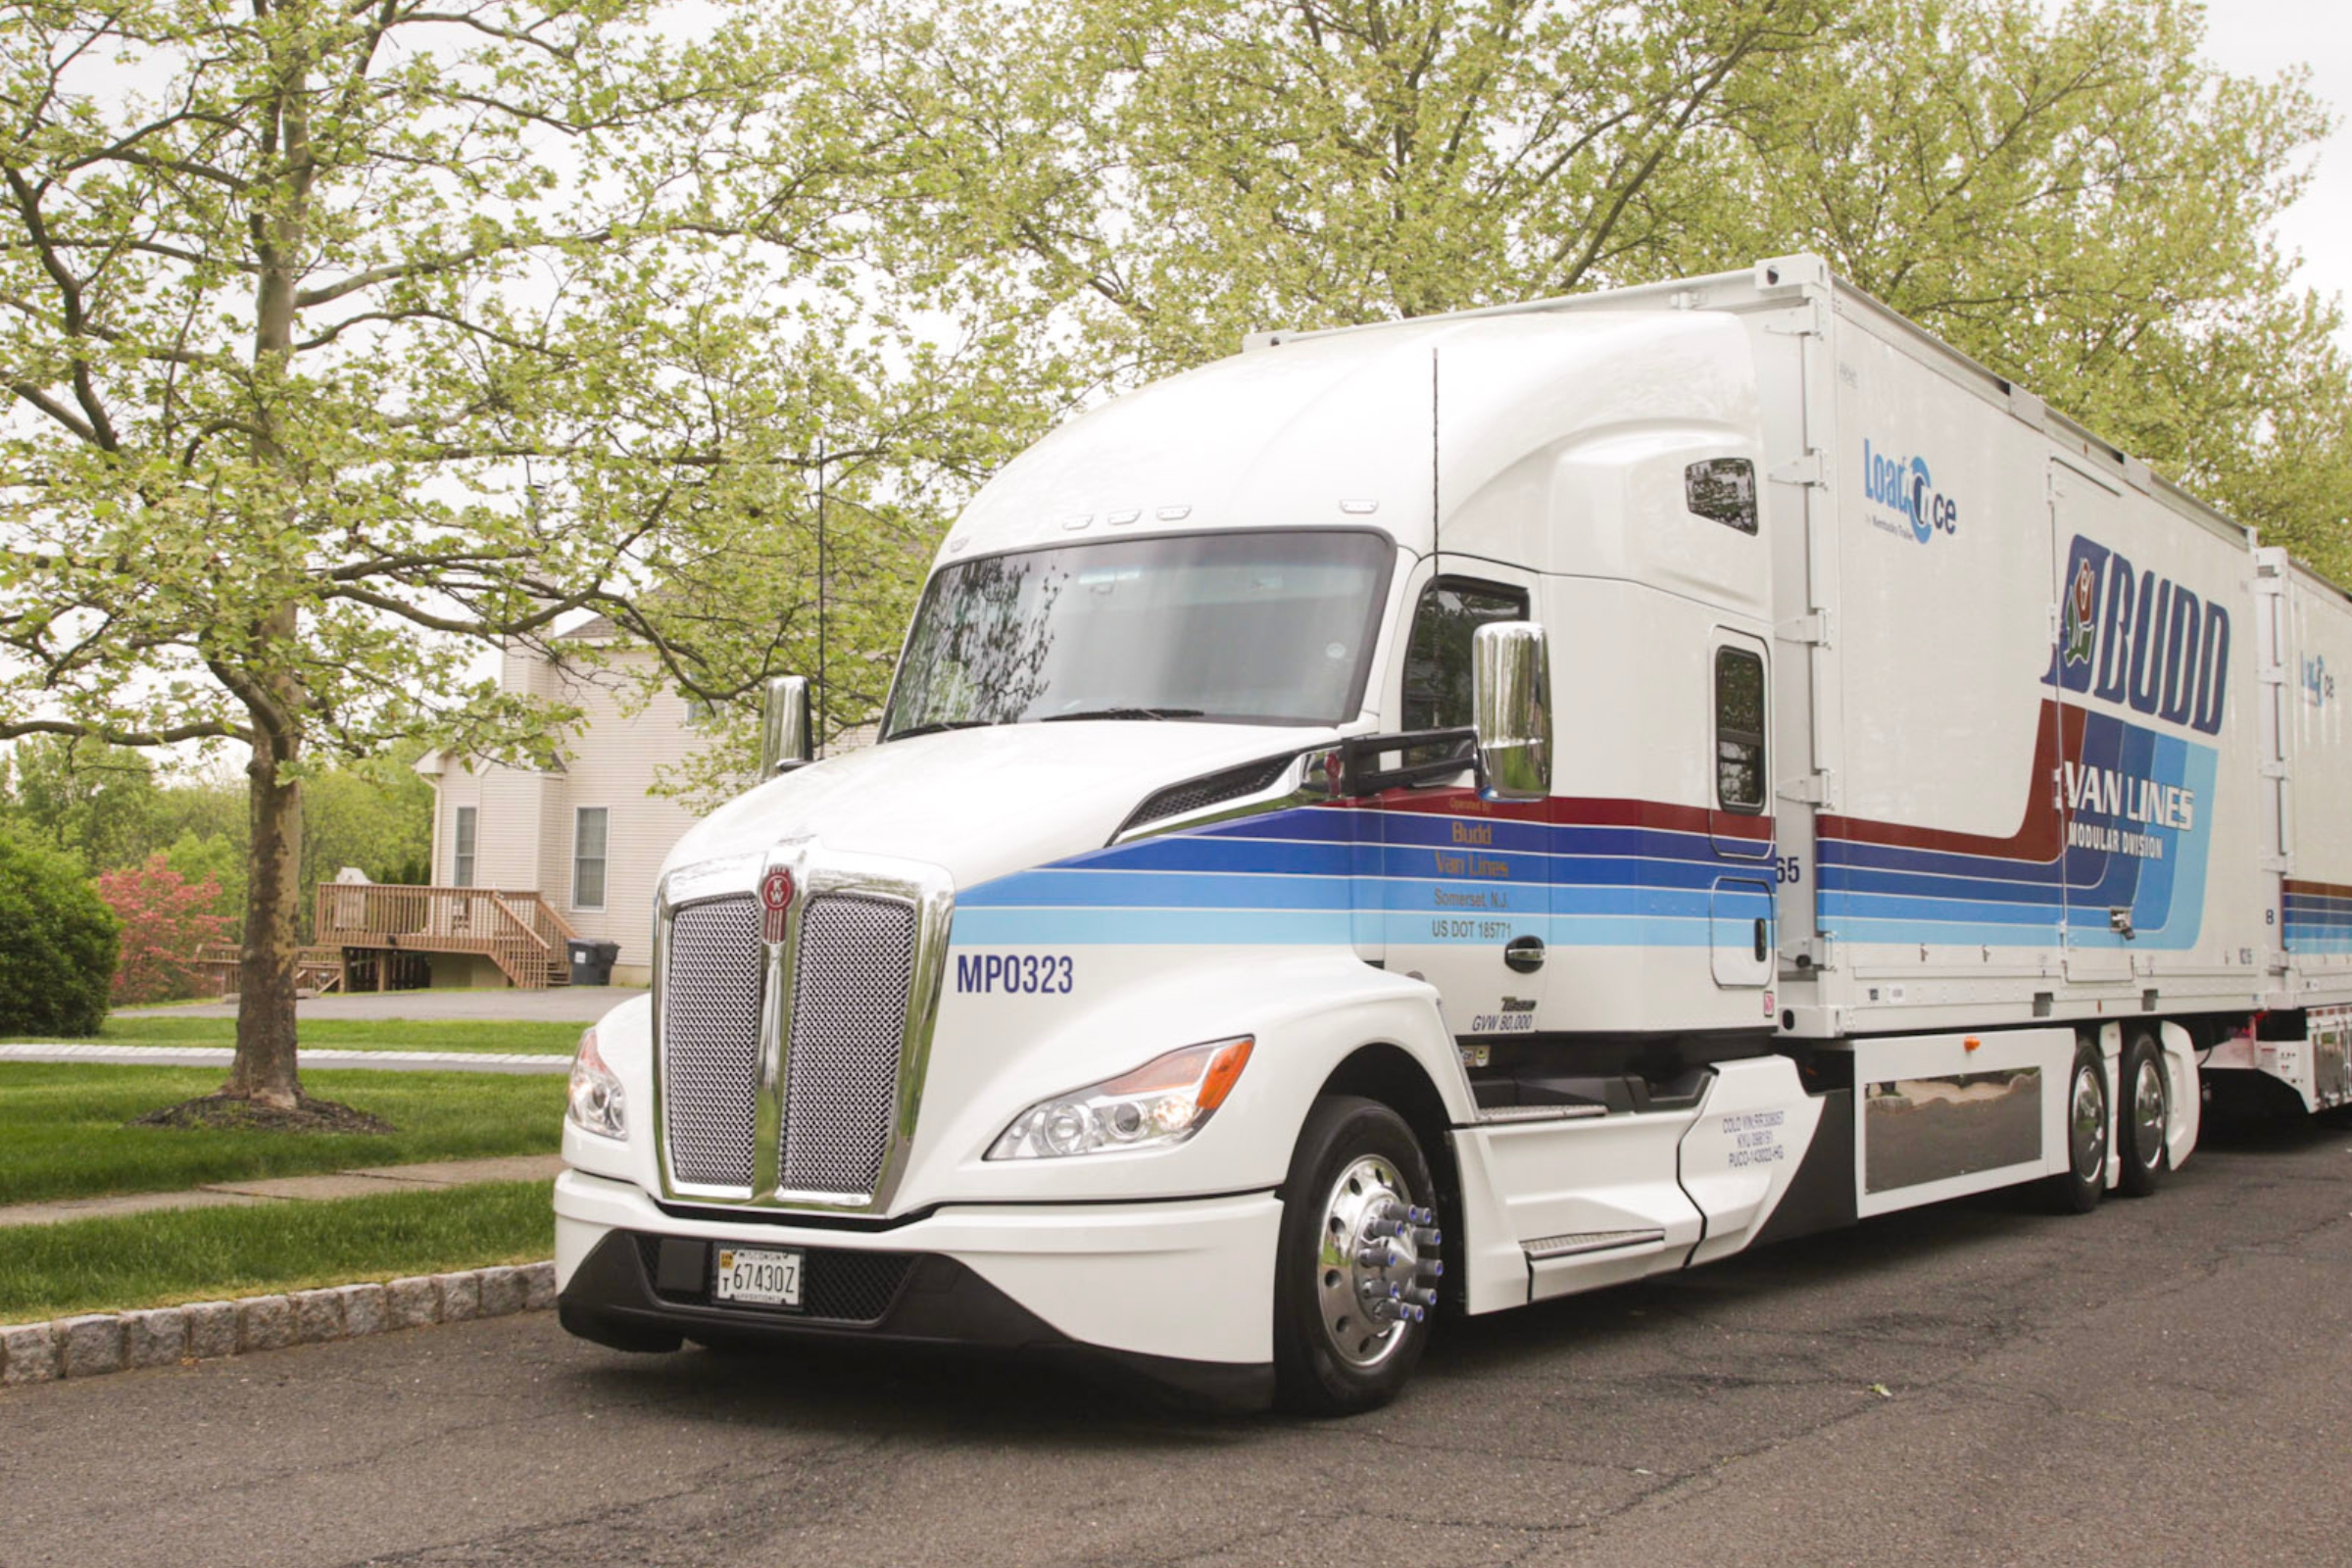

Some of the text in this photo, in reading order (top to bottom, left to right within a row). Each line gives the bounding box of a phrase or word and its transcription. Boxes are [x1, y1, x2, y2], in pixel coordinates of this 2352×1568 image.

[2093, 552, 2230, 736] BUDD
[2064, 760, 2195, 831] VAN LINES
[1451, 820, 1492, 845] Budd
[2069, 821, 2164, 859] MODULAR DIVISION
[1434, 850, 1509, 878] Van Lines
[1432, 919, 1511, 939] US DOT 185771
[956, 954, 1074, 994] MP0323
[1472, 1013, 1533, 1033] GVW 80,000
[733, 1263, 795, 1294] 67430Z
